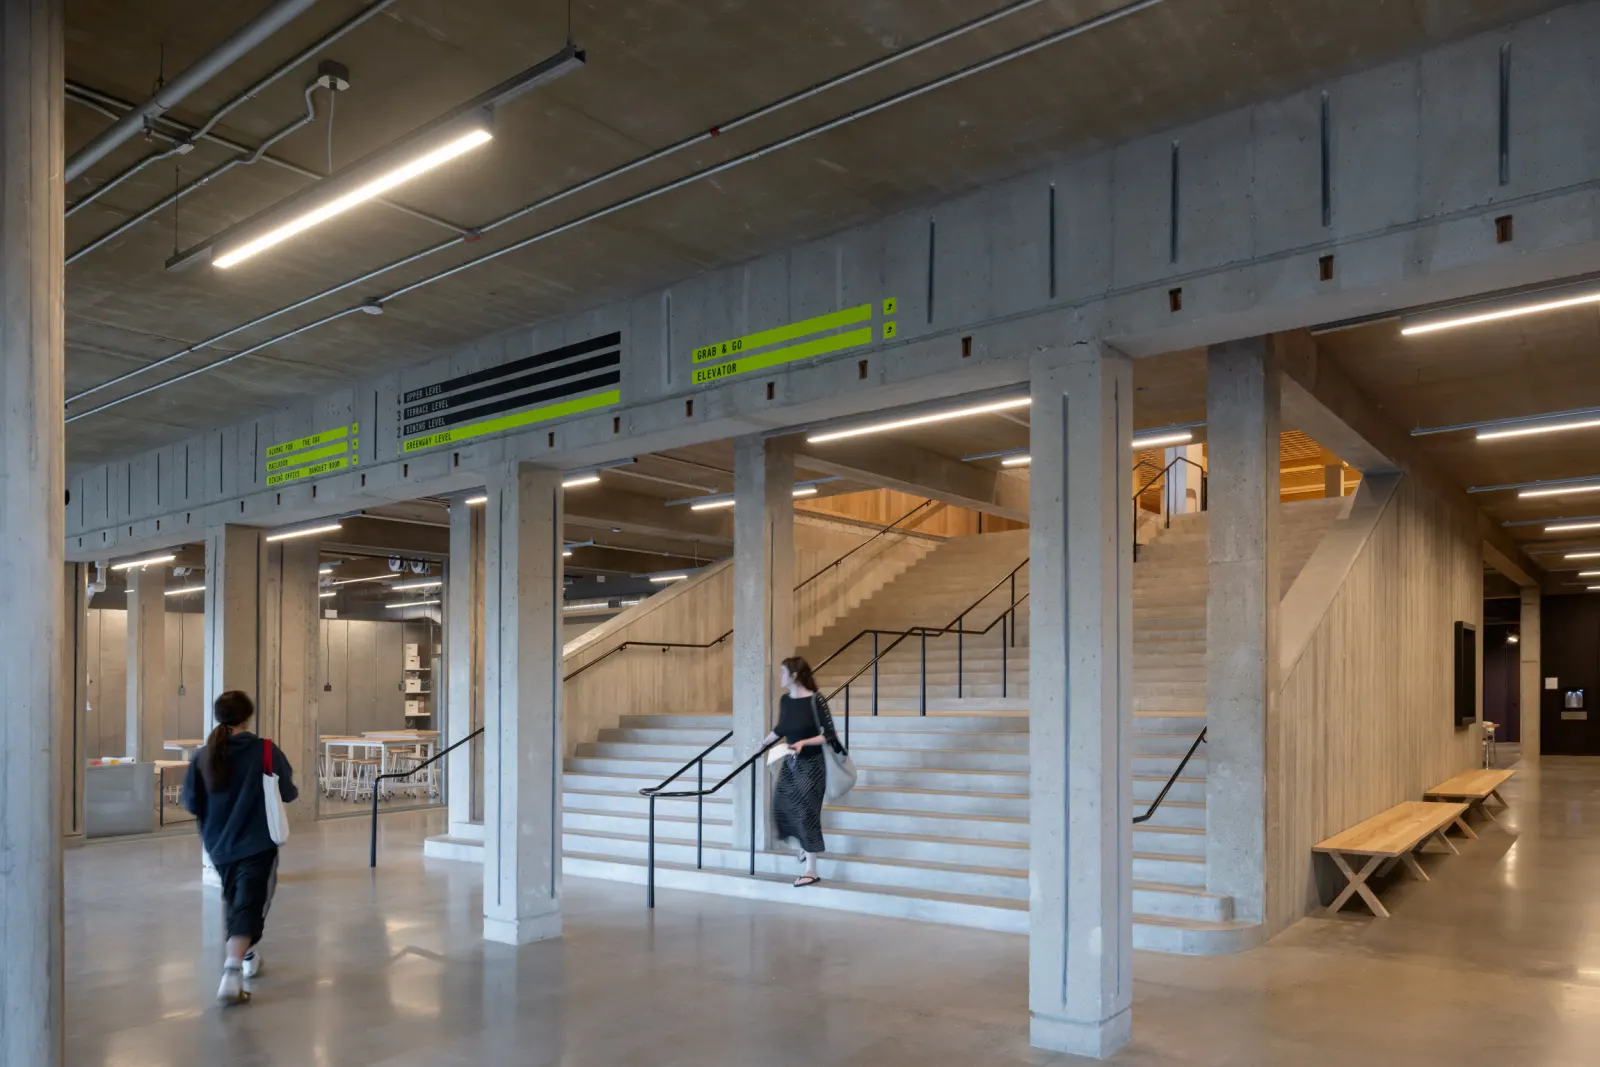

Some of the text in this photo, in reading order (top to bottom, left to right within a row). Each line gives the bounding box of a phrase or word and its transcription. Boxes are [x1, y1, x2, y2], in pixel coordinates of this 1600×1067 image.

[697, 340, 742, 360] GRAB & GO
[697, 362, 737, 382] ELEVATOR
[396, 394, 401, 405] 4
[406, 385, 442, 402] UPPER LEVEL
[396, 411, 402, 422] 3
[406, 400, 448, 417] TERRACE LEVEL
[396, 427, 402, 438] 2
[406, 417, 446, 434] DINING LEVEL
[406, 432, 452, 450] GREENWAY LEVEL
[329, 460, 340, 469] ROOM
[285, 470, 300, 480] OFFICE
